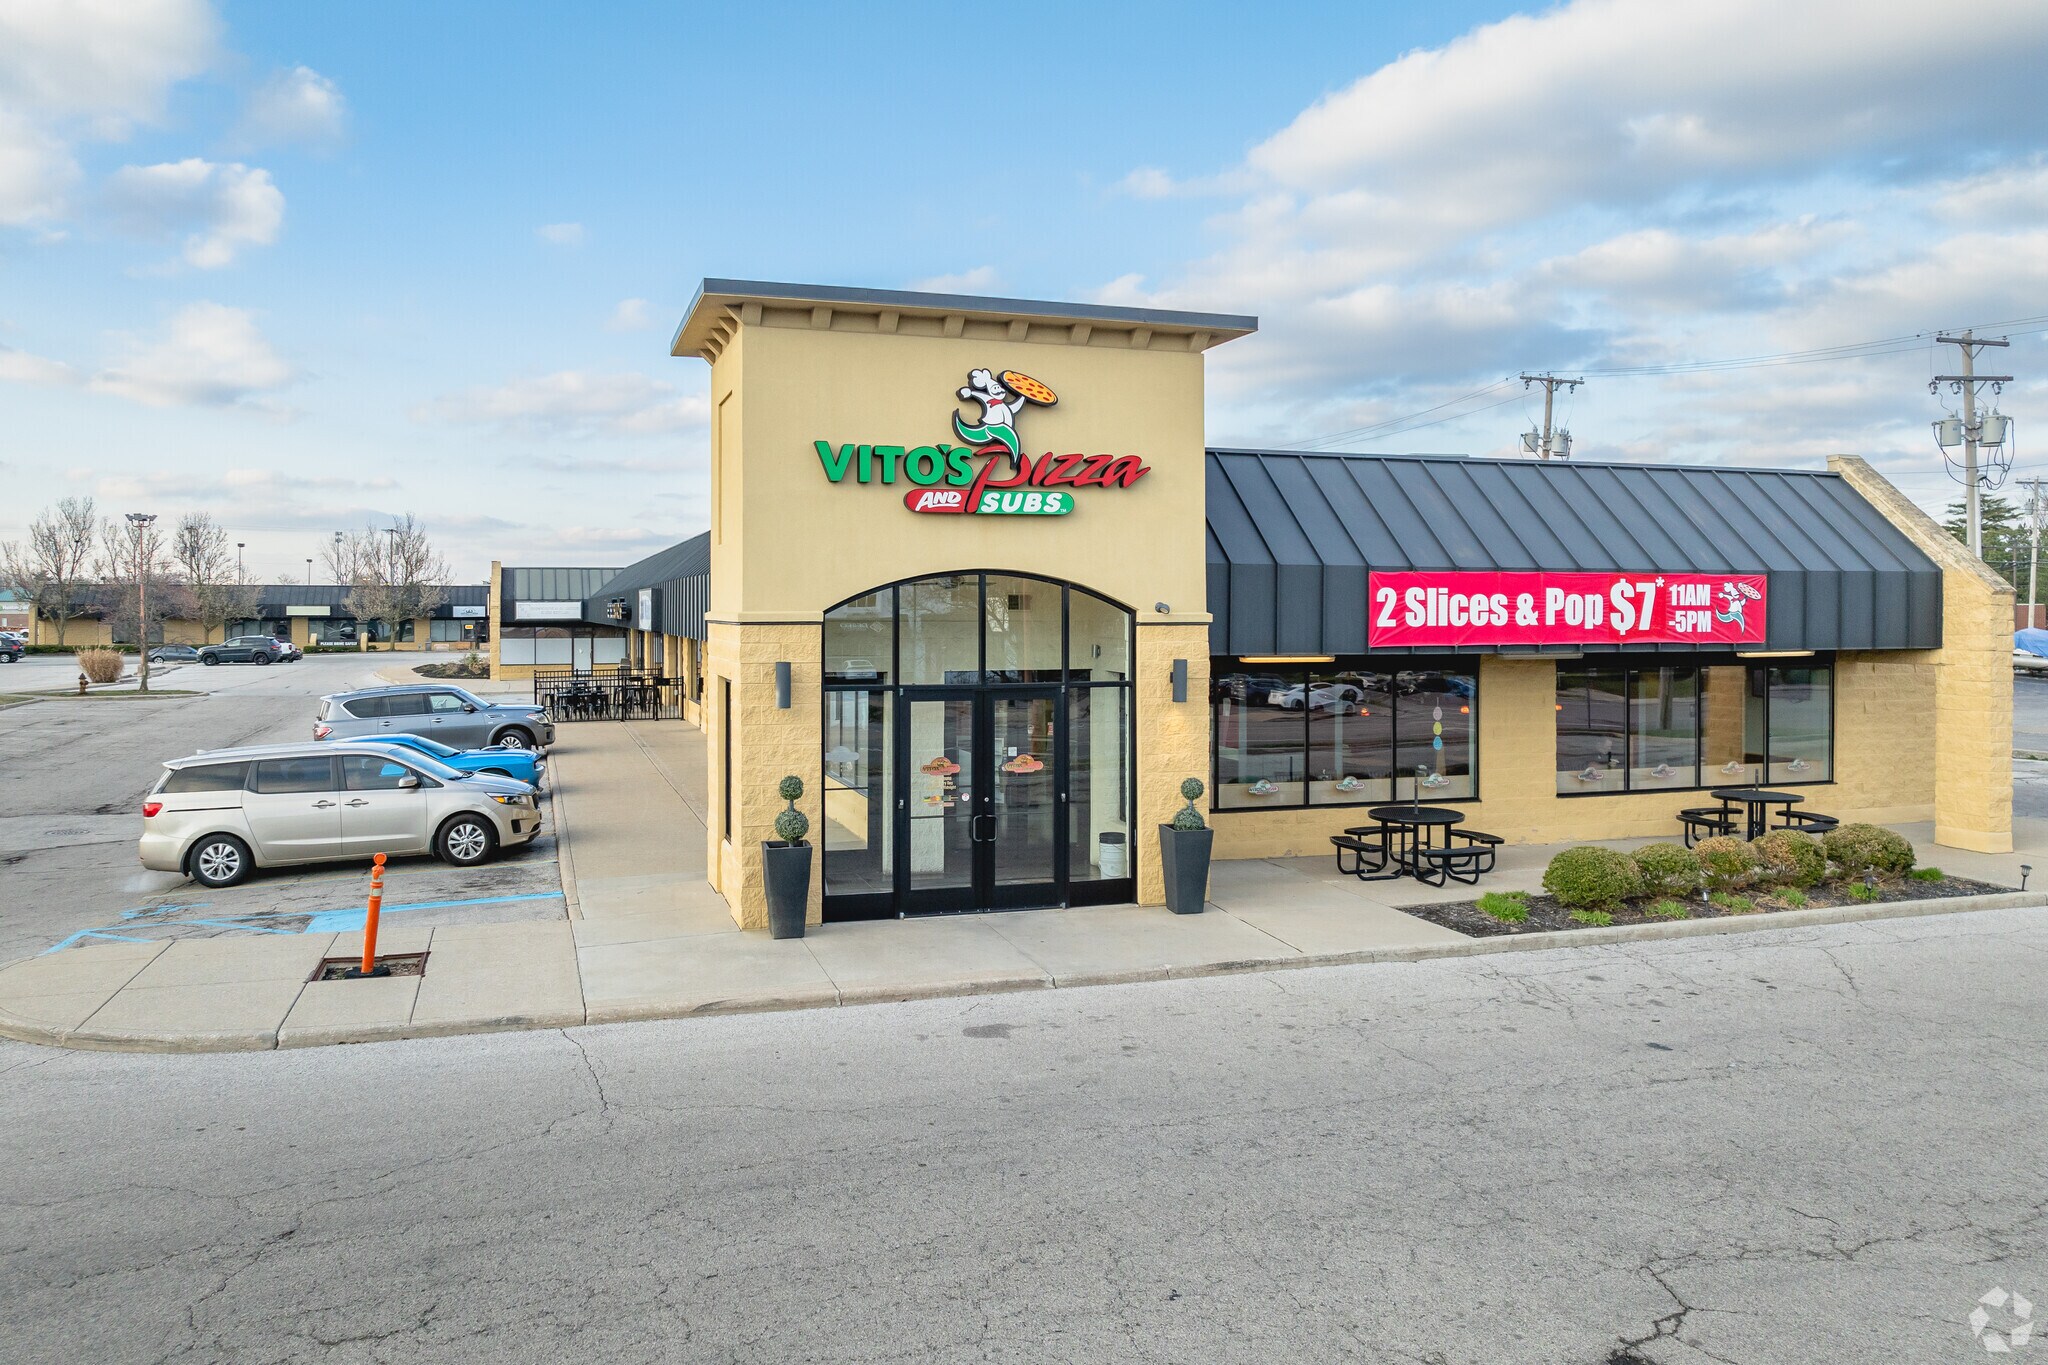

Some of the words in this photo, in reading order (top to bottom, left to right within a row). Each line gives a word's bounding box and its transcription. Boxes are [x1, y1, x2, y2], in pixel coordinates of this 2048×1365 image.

[814, 440, 973, 485] VITO'S
[915, 491, 962, 511] AND
[980, 492, 1062, 513] SUBS
[1669, 584, 1711, 606] 11AM
[1376, 587, 1397, 627] 2
[1405, 586, 1509, 627] Slices
[1515, 592, 1539, 626] &
[1545, 588, 1604, 629] Pop
[1669, 611, 1712, 633] -5PM
